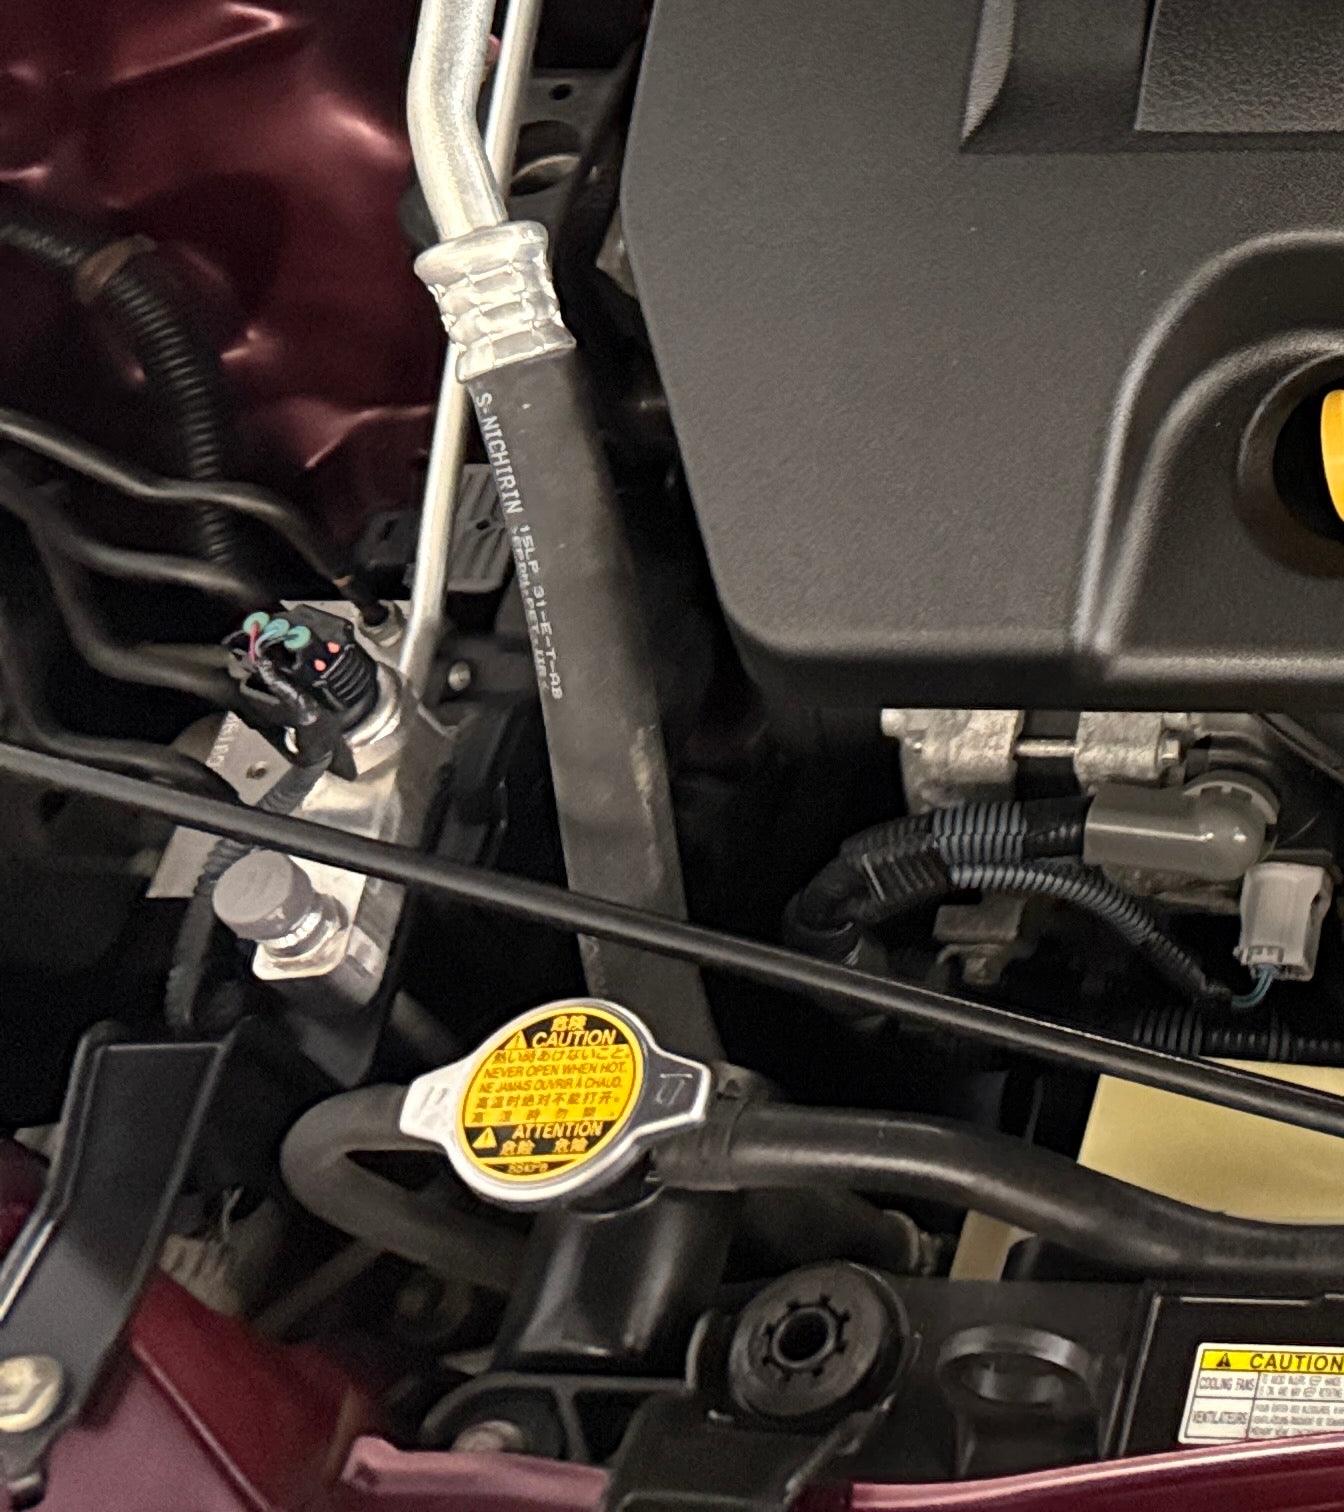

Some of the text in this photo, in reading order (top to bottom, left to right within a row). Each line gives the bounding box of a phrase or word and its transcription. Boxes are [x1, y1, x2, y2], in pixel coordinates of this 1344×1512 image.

[532, 1029, 617, 1048] CAUTION
[484, 1065, 525, 1079] NEVER
[525, 1063, 559, 1078] OPEN
[562, 1062, 597, 1075] WHEN
[478, 1082, 495, 1094] NE
[512, 1121, 603, 1139] ATTENTION
[1249, 1353, 1344, 1373] CAUTION
